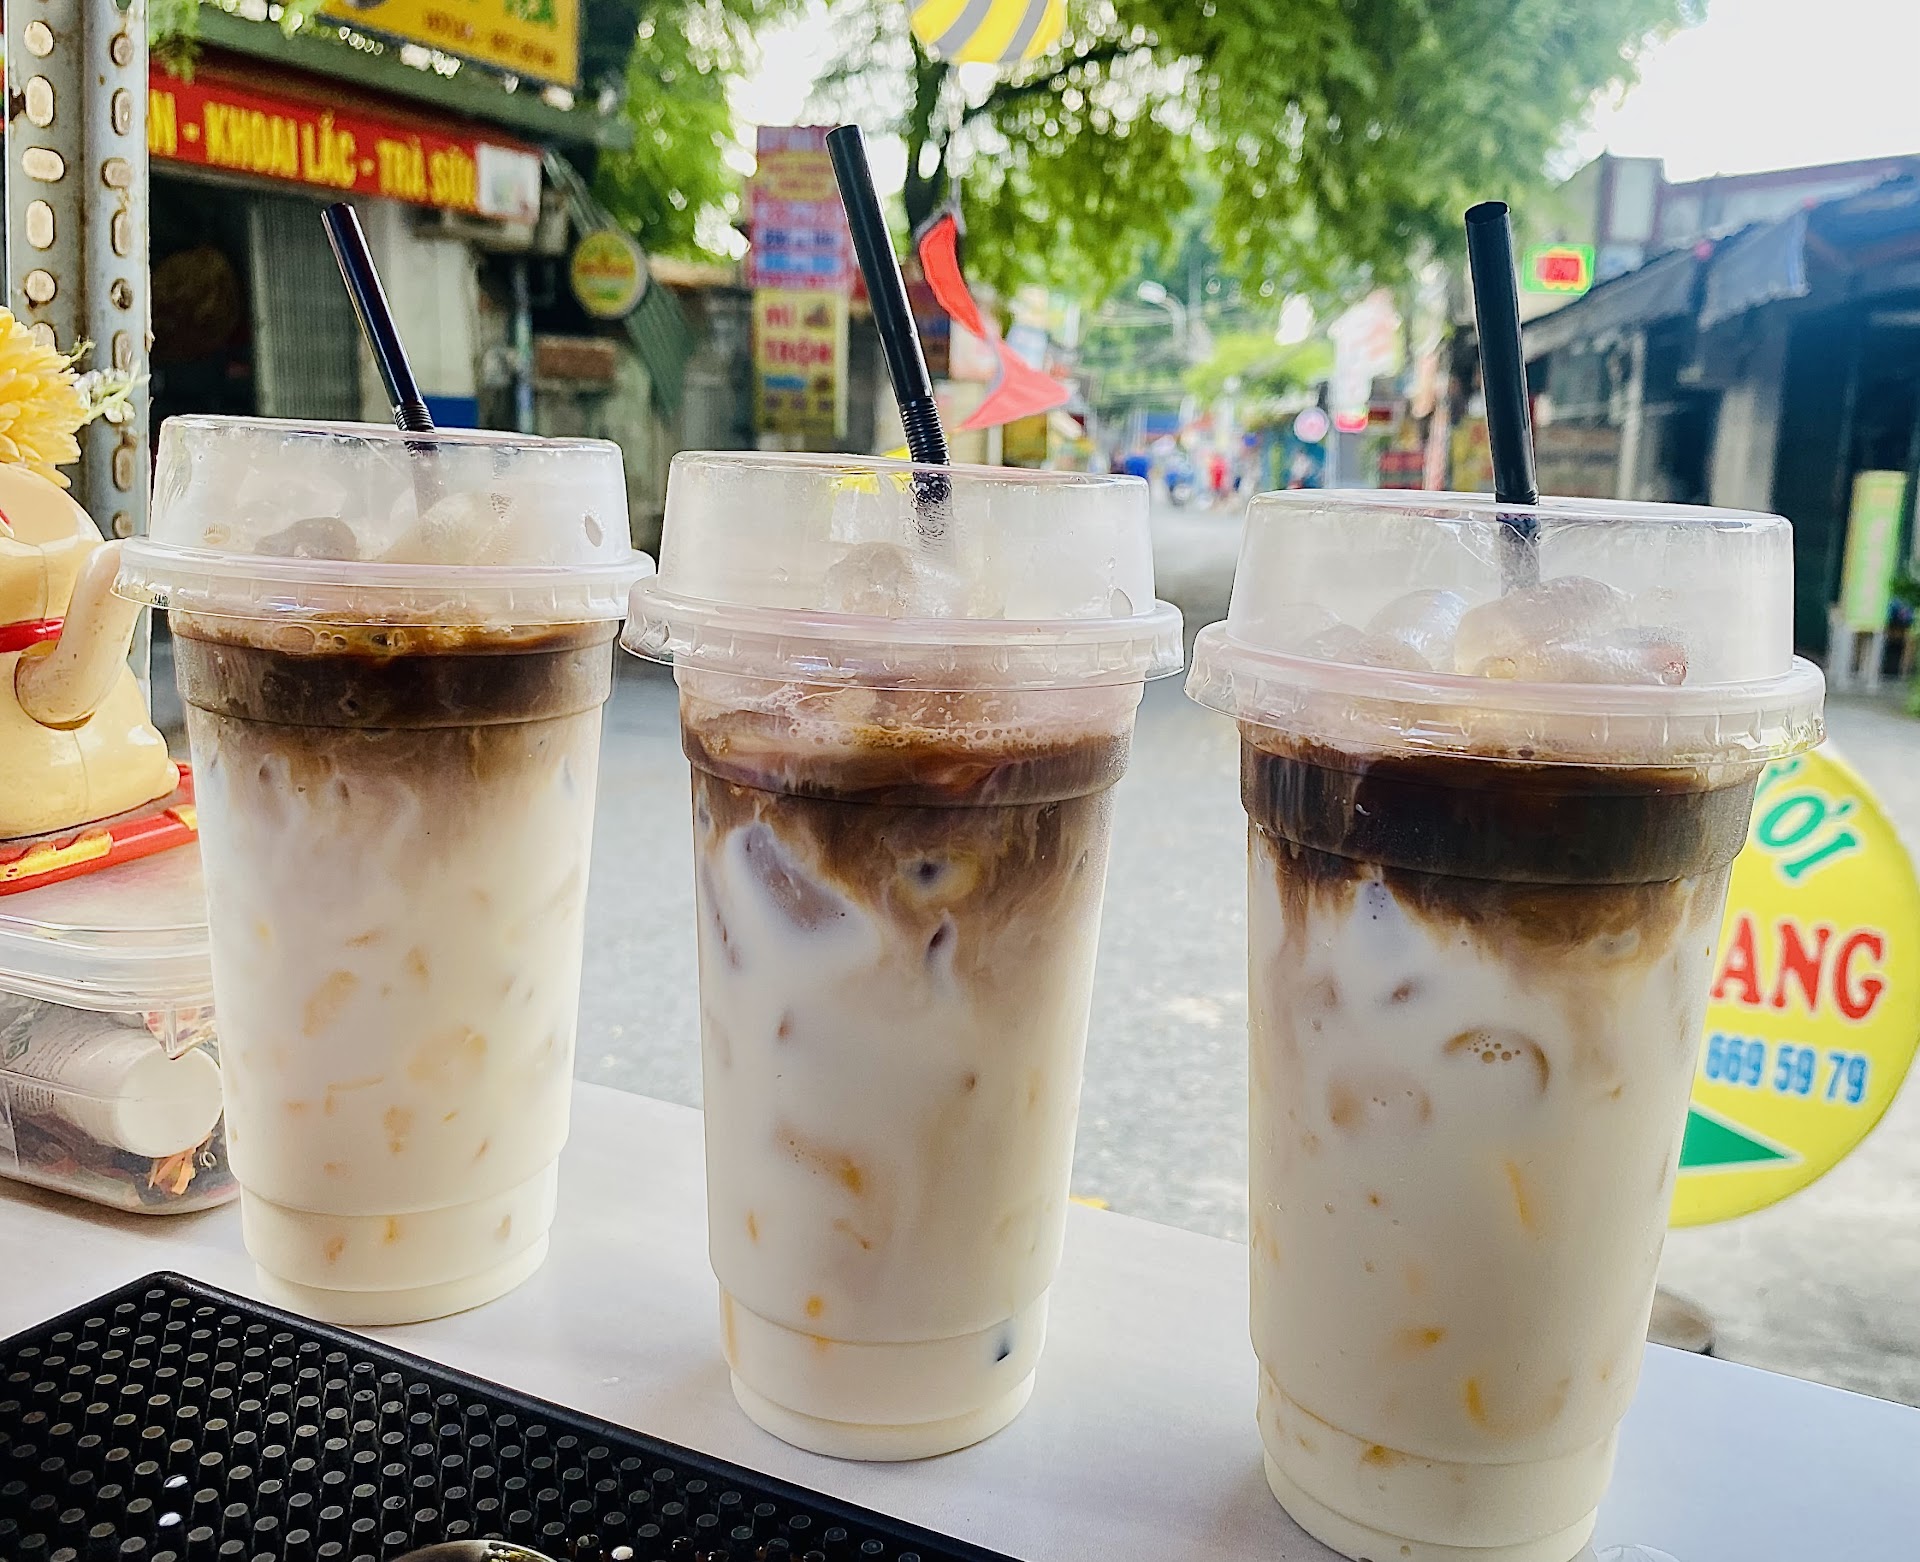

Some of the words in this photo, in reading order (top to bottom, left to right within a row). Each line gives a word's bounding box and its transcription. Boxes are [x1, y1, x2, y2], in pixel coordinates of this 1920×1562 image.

[204, 101, 298, 179] KHOAI
[1774, 1046, 1815, 1095] 59
[1827, 1053, 1867, 1104] 79
